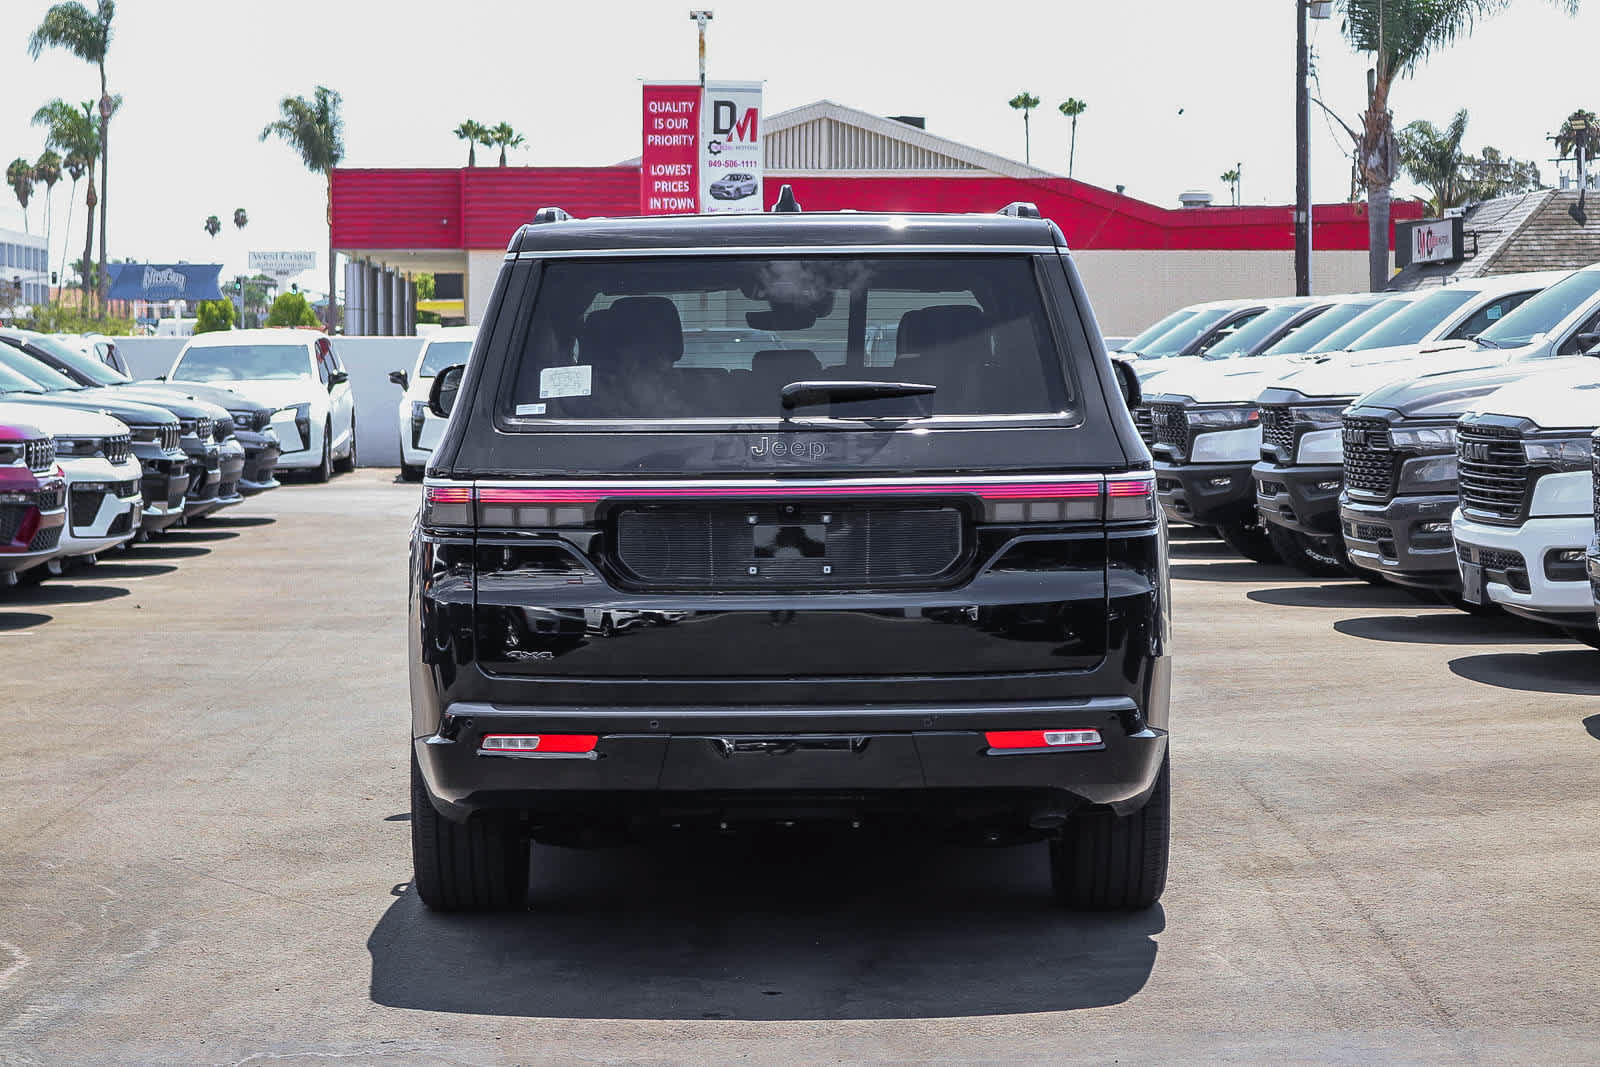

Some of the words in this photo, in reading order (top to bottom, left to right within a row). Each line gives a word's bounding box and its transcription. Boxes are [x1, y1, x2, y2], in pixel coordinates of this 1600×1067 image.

[649, 101, 695, 113] QUALITY
[654, 118, 664, 129] IS
[666, 118, 689, 129] OUR
[713, 100, 758, 142] DM
[648, 135, 695, 146] PRIORITY
[651, 164, 693, 176] LOWEST
[654, 180, 690, 192] PRICES
[650, 197, 661, 209] IN
[663, 197, 695, 209] TOWN
[751, 436, 826, 461] Jeep
